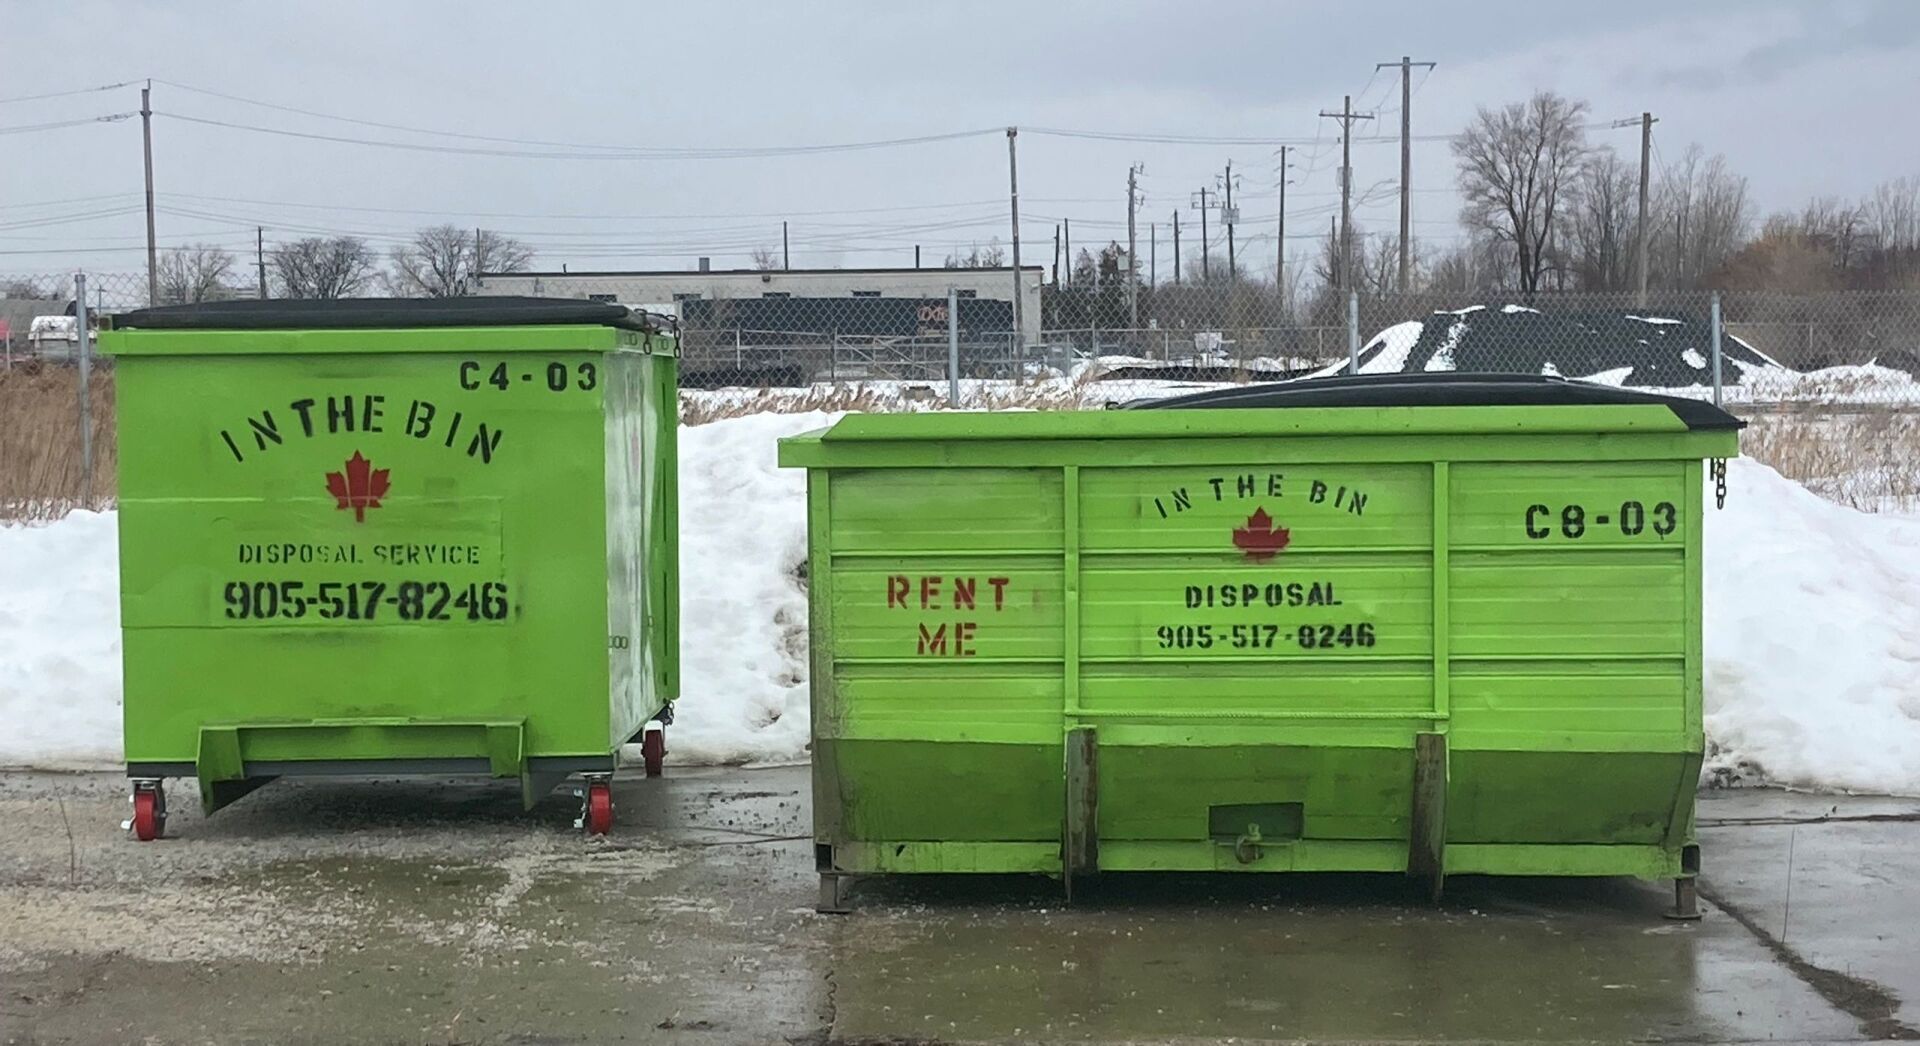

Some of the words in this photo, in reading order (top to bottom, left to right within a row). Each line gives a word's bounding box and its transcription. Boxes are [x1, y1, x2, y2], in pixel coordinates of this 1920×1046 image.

[459, 360, 596, 392] C4-03
[220, 410, 283, 463] IN
[290, 395, 386, 438] THE
[404, 399, 504, 465] BIN
[1154, 487, 1192, 519] IN
[1208, 474, 1284, 501] THE
[1308, 479, 1368, 517] BIN
[1524, 500, 1677, 539] C8-03
[239, 543, 364, 565] DISPOSAL
[373, 543, 480, 566] SERVICE
[224, 580, 509, 621] 905-517-8246
[887, 575, 1010, 612] RENT
[1185, 582, 1343, 609] DISPOSAL
[917, 621, 978, 656] ME
[1157, 622, 1377, 649] 905-517-8246
